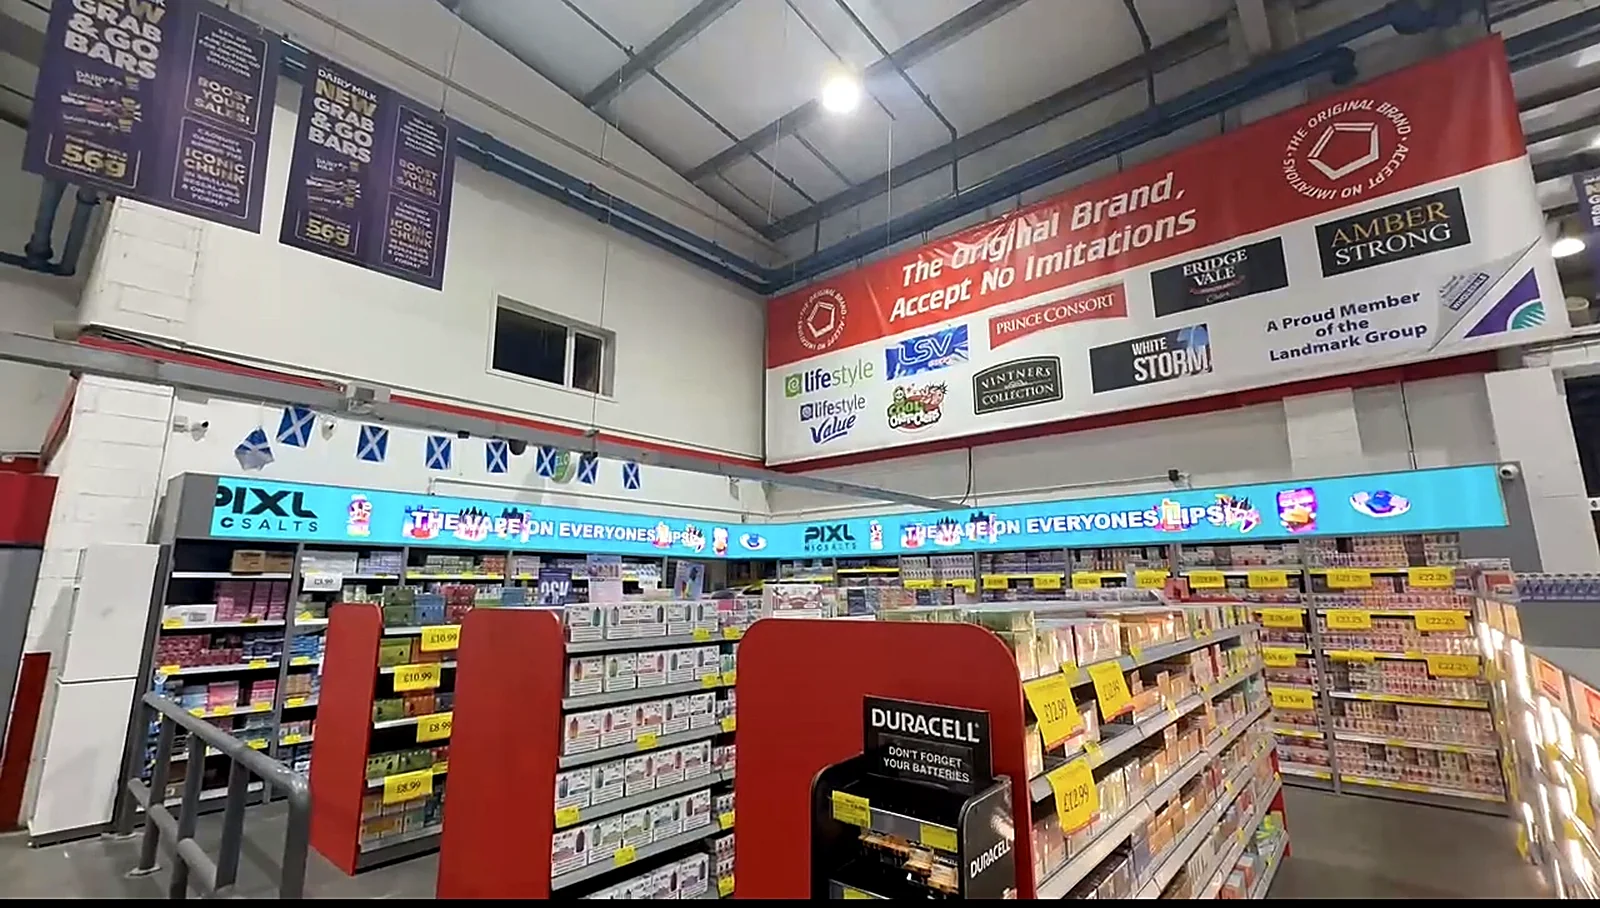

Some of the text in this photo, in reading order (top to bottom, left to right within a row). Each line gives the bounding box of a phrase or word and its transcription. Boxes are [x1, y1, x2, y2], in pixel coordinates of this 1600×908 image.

[72, 0, 161, 42] GRAB
[68, 13, 160, 60] & GO
[64, 30, 157, 79] BARS
[198, 76, 253, 104] BOOST
[315, 78, 377, 117] NEW
[317, 68, 377, 102] DAIRY MILK
[194, 97, 250, 125] SALES!
[202, 88, 246, 113] YOUR
[313, 97, 374, 133] GRAB
[311, 112, 373, 147] & GO
[308, 126, 371, 163] BARS
[1283, 99, 1412, 200] THE ORIGINAL BRAND ACCEPT NO IMITATIONS
[62, 142, 127, 178] 56g
[183, 158, 245, 185] CHUNK
[185, 147, 246, 174] ICONIC
[399, 158, 438, 180] BOOST
[396, 176, 437, 197] SALES!
[402, 169, 433, 188] YOUR
[306, 218, 351, 247] 56g
[390, 218, 433, 240] ICONIC
[902, 171, 1185, 288] The Original Brand,
[1331, 200, 1451, 247] AMBER
[389, 228, 432, 249] CHUNK
[1335, 222, 1452, 266] STRONG
[889, 208, 1198, 323] Accept No Imitations
[1182, 249, 1248, 276] ERIDGE
[1194, 266, 1236, 286] VALE
[996, 294, 1117, 336] PRINCE CONSORT
[1266, 291, 1421, 333] A Proud Member
[1269, 323, 1428, 362] Landmark Group
[1315, 318, 1370, 339] of the
[899, 333, 953, 365] LSV
[1131, 338, 1168, 356] WHITE
[804, 359, 875, 393] lifestyle
[981, 365, 1052, 389] VINTNERS
[1134, 343, 1213, 382] STORM
[814, 395, 866, 418] lifestyle
[981, 383, 1055, 407] COLLECTION
[811, 414, 857, 444] Value
[214, 485, 318, 520] PIXL
[411, 509, 460, 531] THE
[463, 514, 521, 535] VAPE
[527, 519, 554, 537] ON
[559, 521, 657, 542] EVERYONES
[805, 523, 856, 544] PIXL
[905, 504, 1226, 539] THE VAPE ON EVERYONES LIPS
[430, 633, 457, 645] £10.99
[404, 672, 432, 683] £10.99
[871, 708, 980, 744] DURACELL
[1045, 698, 1068, 725] £12.99
[429, 722, 452, 733] £8.99
[884, 757, 970, 783] YOUR BATTERIES
[889, 746, 962, 769] DON'T FORGET
[397, 781, 421, 794] £8.99
[1063, 784, 1089, 813] £12.99
[970, 839, 1011, 879] DURACELL
